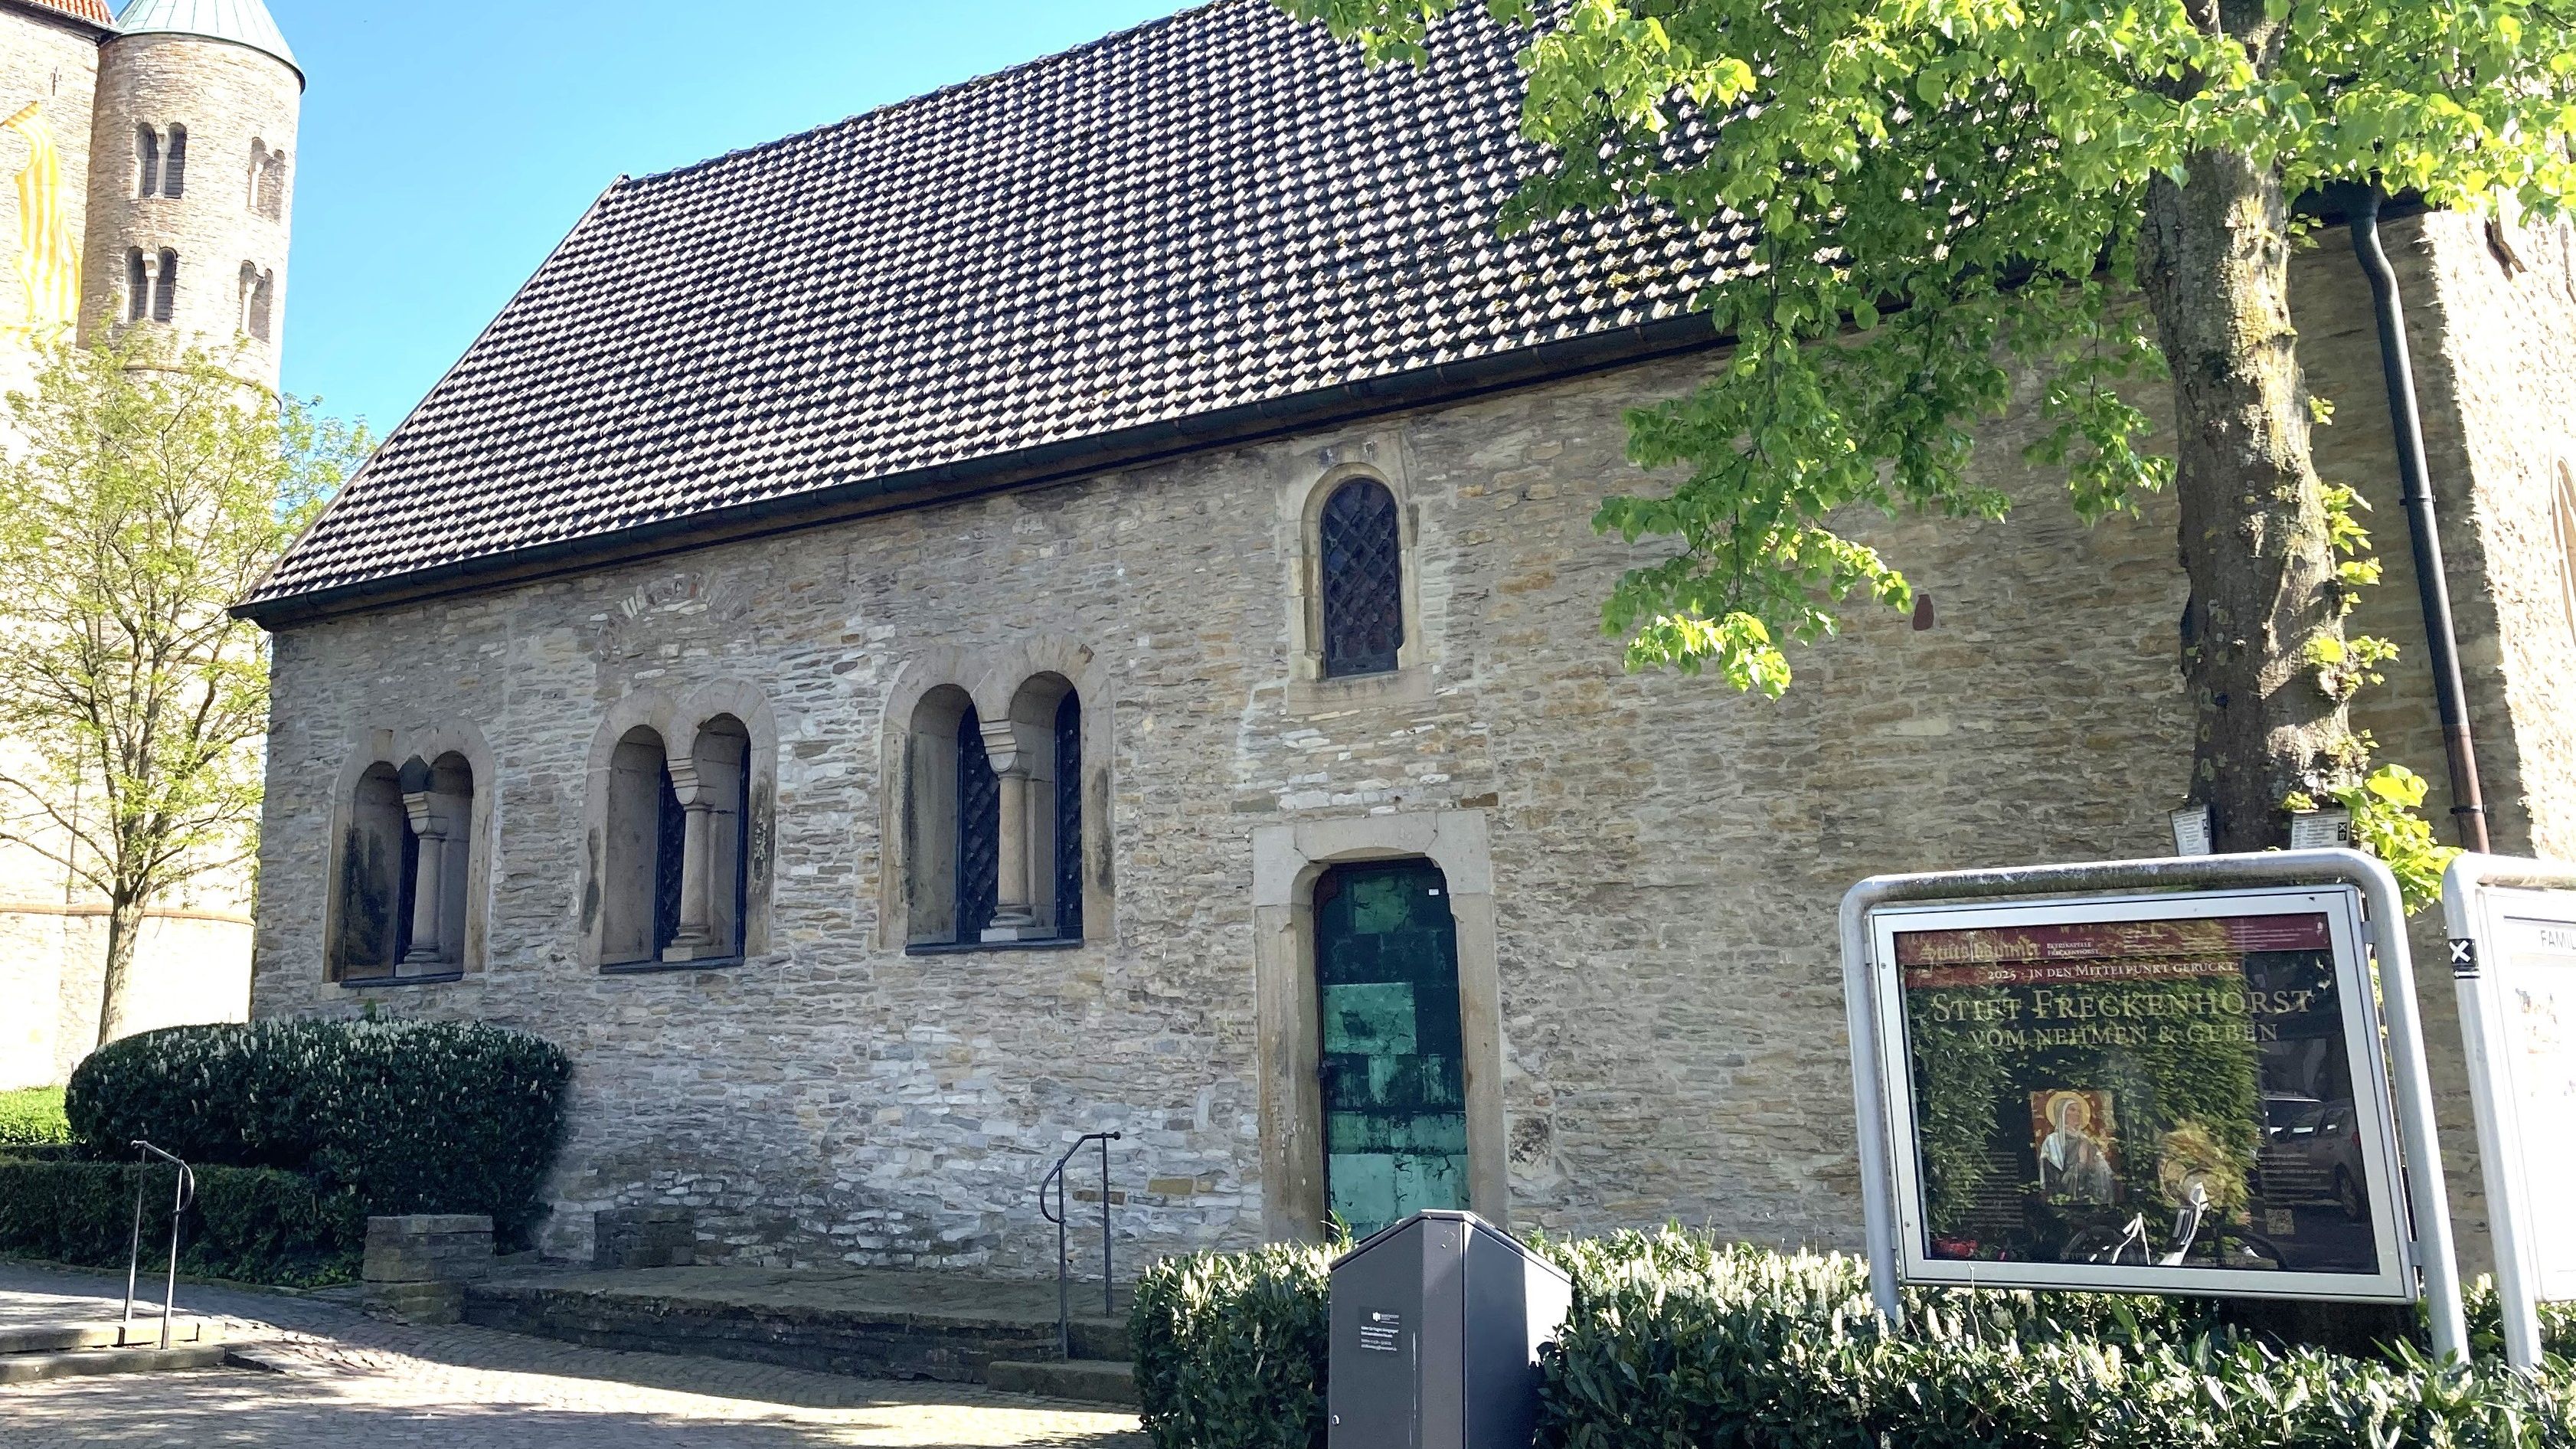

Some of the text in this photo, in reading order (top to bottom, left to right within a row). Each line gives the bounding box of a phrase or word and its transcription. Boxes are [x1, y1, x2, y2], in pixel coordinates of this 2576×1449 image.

[1987, 970, 2016, 980] 2025
[2047, 967, 2071, 977] DEN
[1933, 989, 2313, 1022] STIFT FRECKENHORST
[1970, 1022, 2278, 1048] VOM NEHMEN & GEBEN
